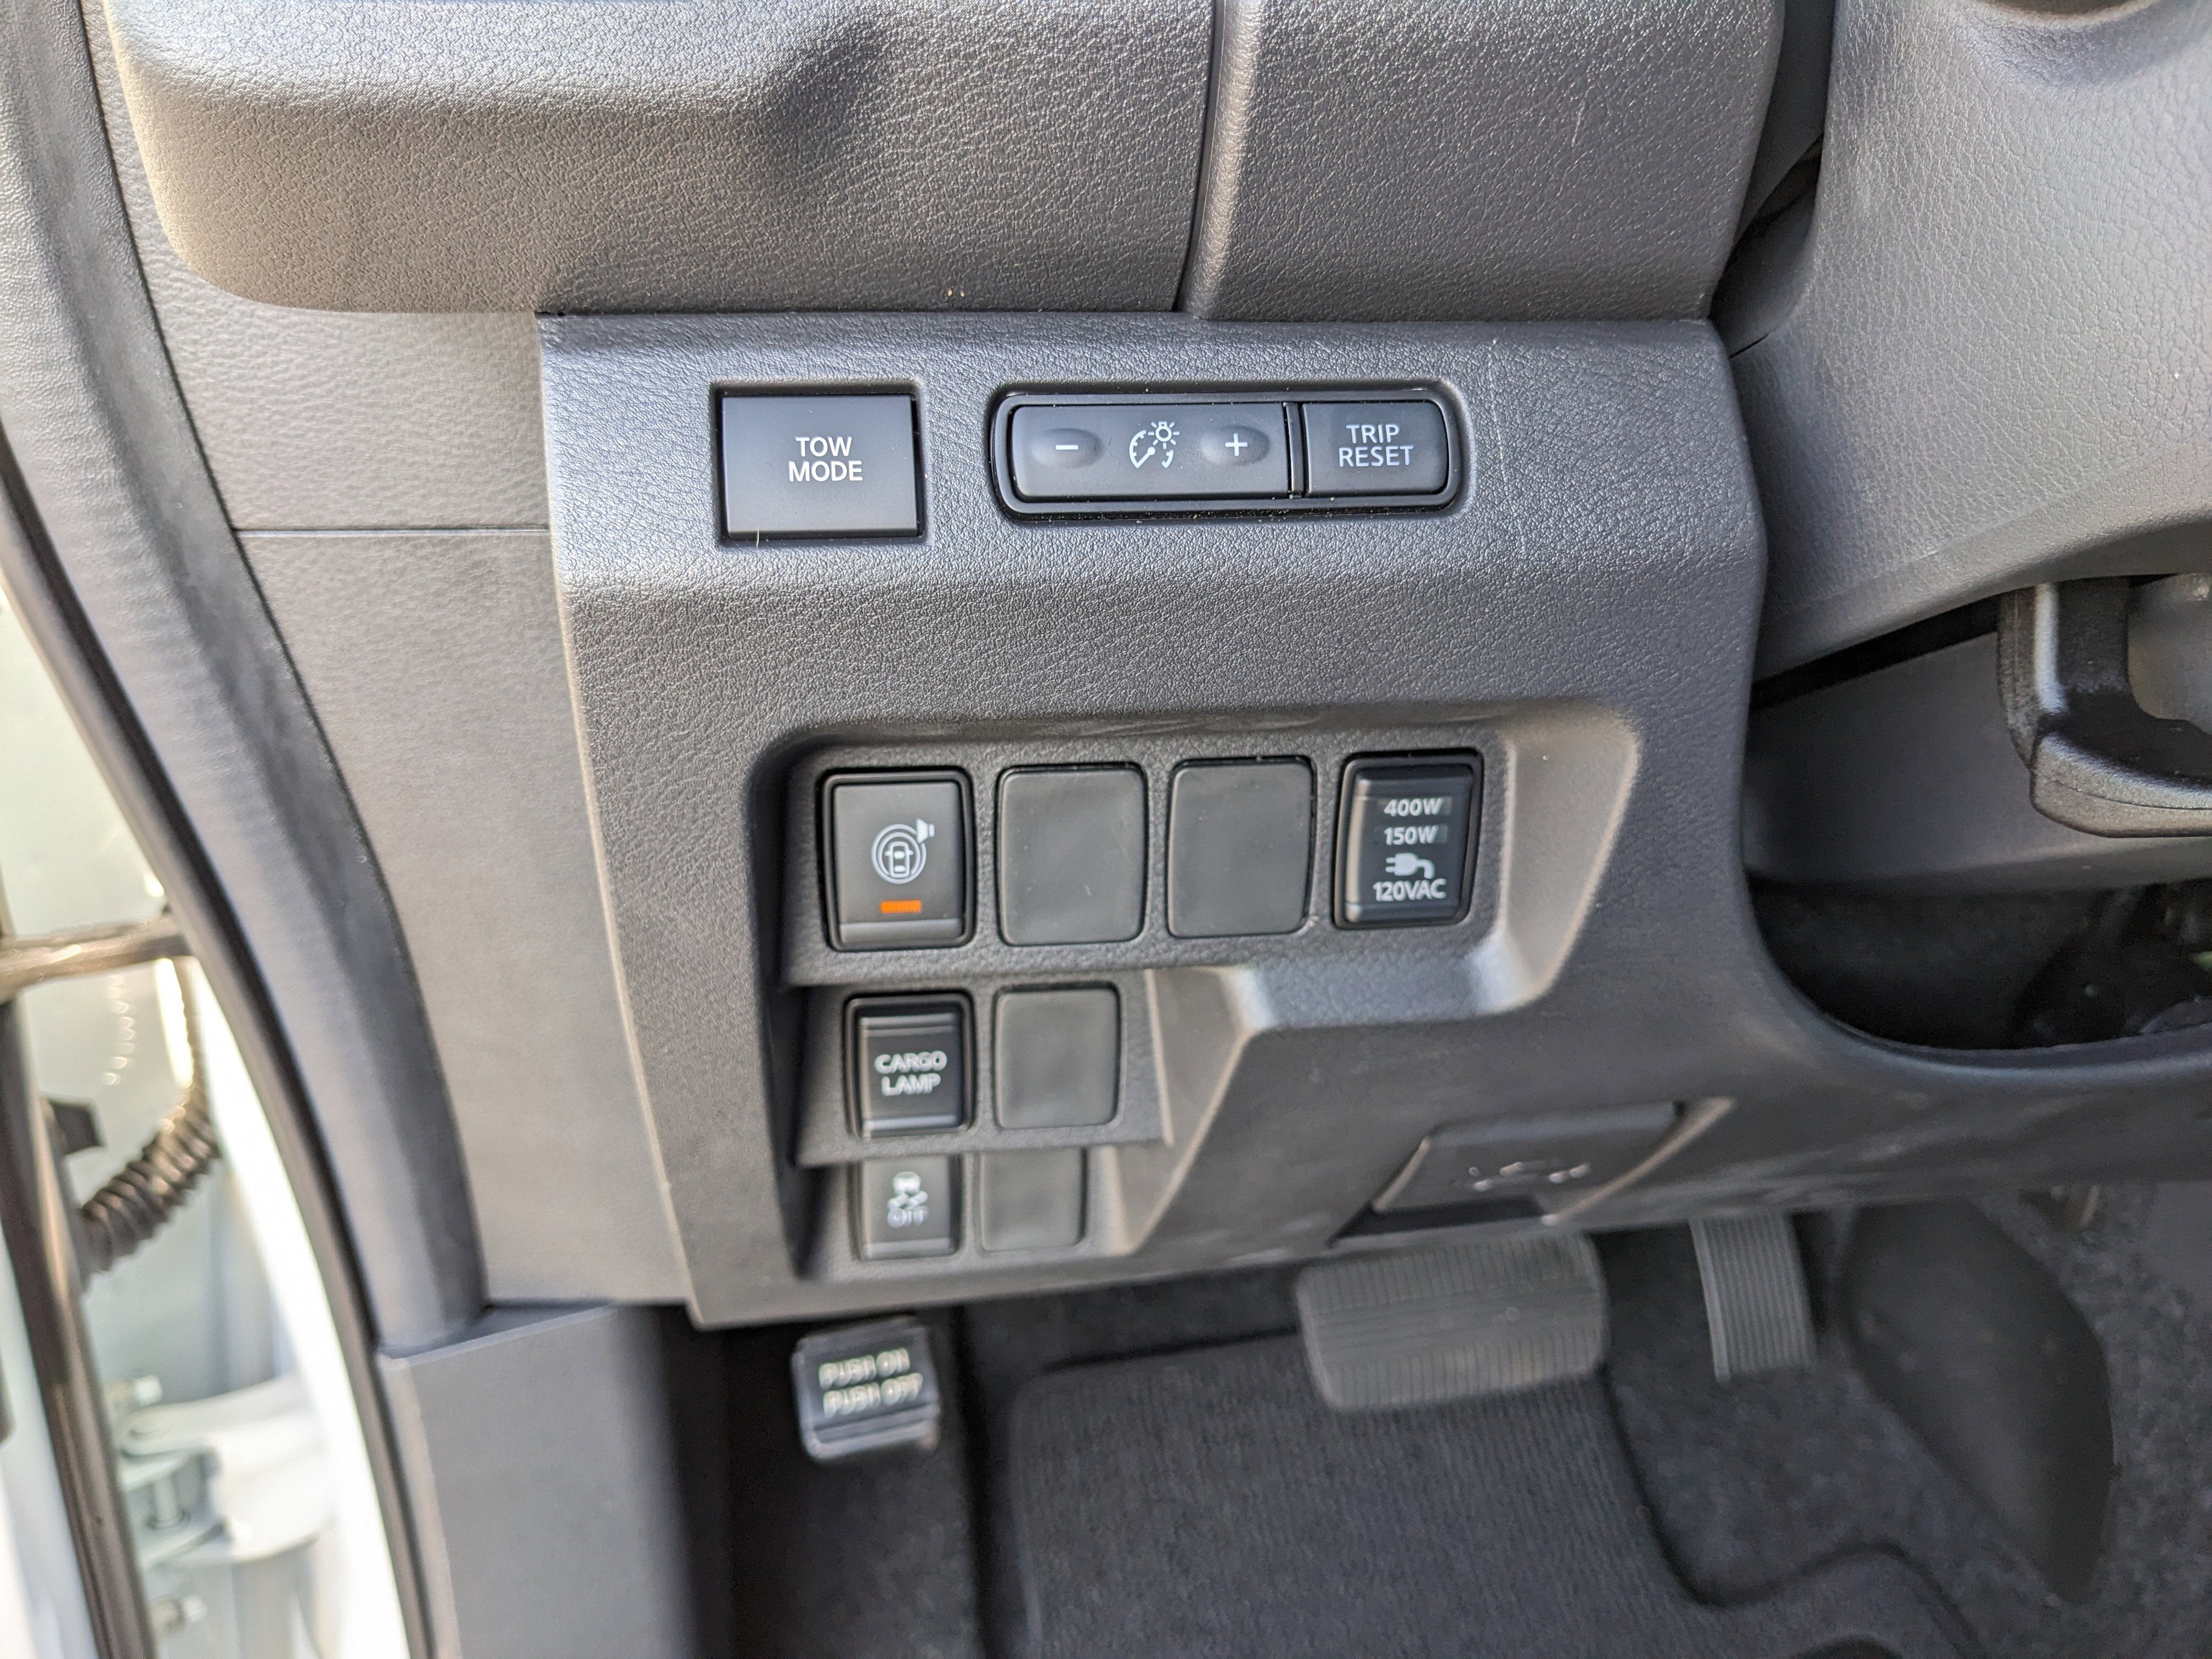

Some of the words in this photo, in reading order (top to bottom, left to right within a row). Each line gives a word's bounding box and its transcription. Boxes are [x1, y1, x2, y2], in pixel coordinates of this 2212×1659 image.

[1346, 425, 1400, 443] TRIP
[795, 437, 852, 457] TOW
[1339, 446, 1413, 467] RESET
[789, 461, 863, 482] MODE
[1384, 798, 1443, 816] 400W
[1384, 826, 1438, 845] 150W
[1373, 878, 1447, 901] 120VAC
[874, 1051, 947, 1073] CARGO
[882, 1074, 941, 1096] LAMP
[887, 1207, 928, 1227] OFF
[819, 1355, 876, 1390] PUSH
[877, 1348, 910, 1378] ON
[823, 1383, 881, 1418] PUSH
[881, 1373, 923, 1406] OFF
